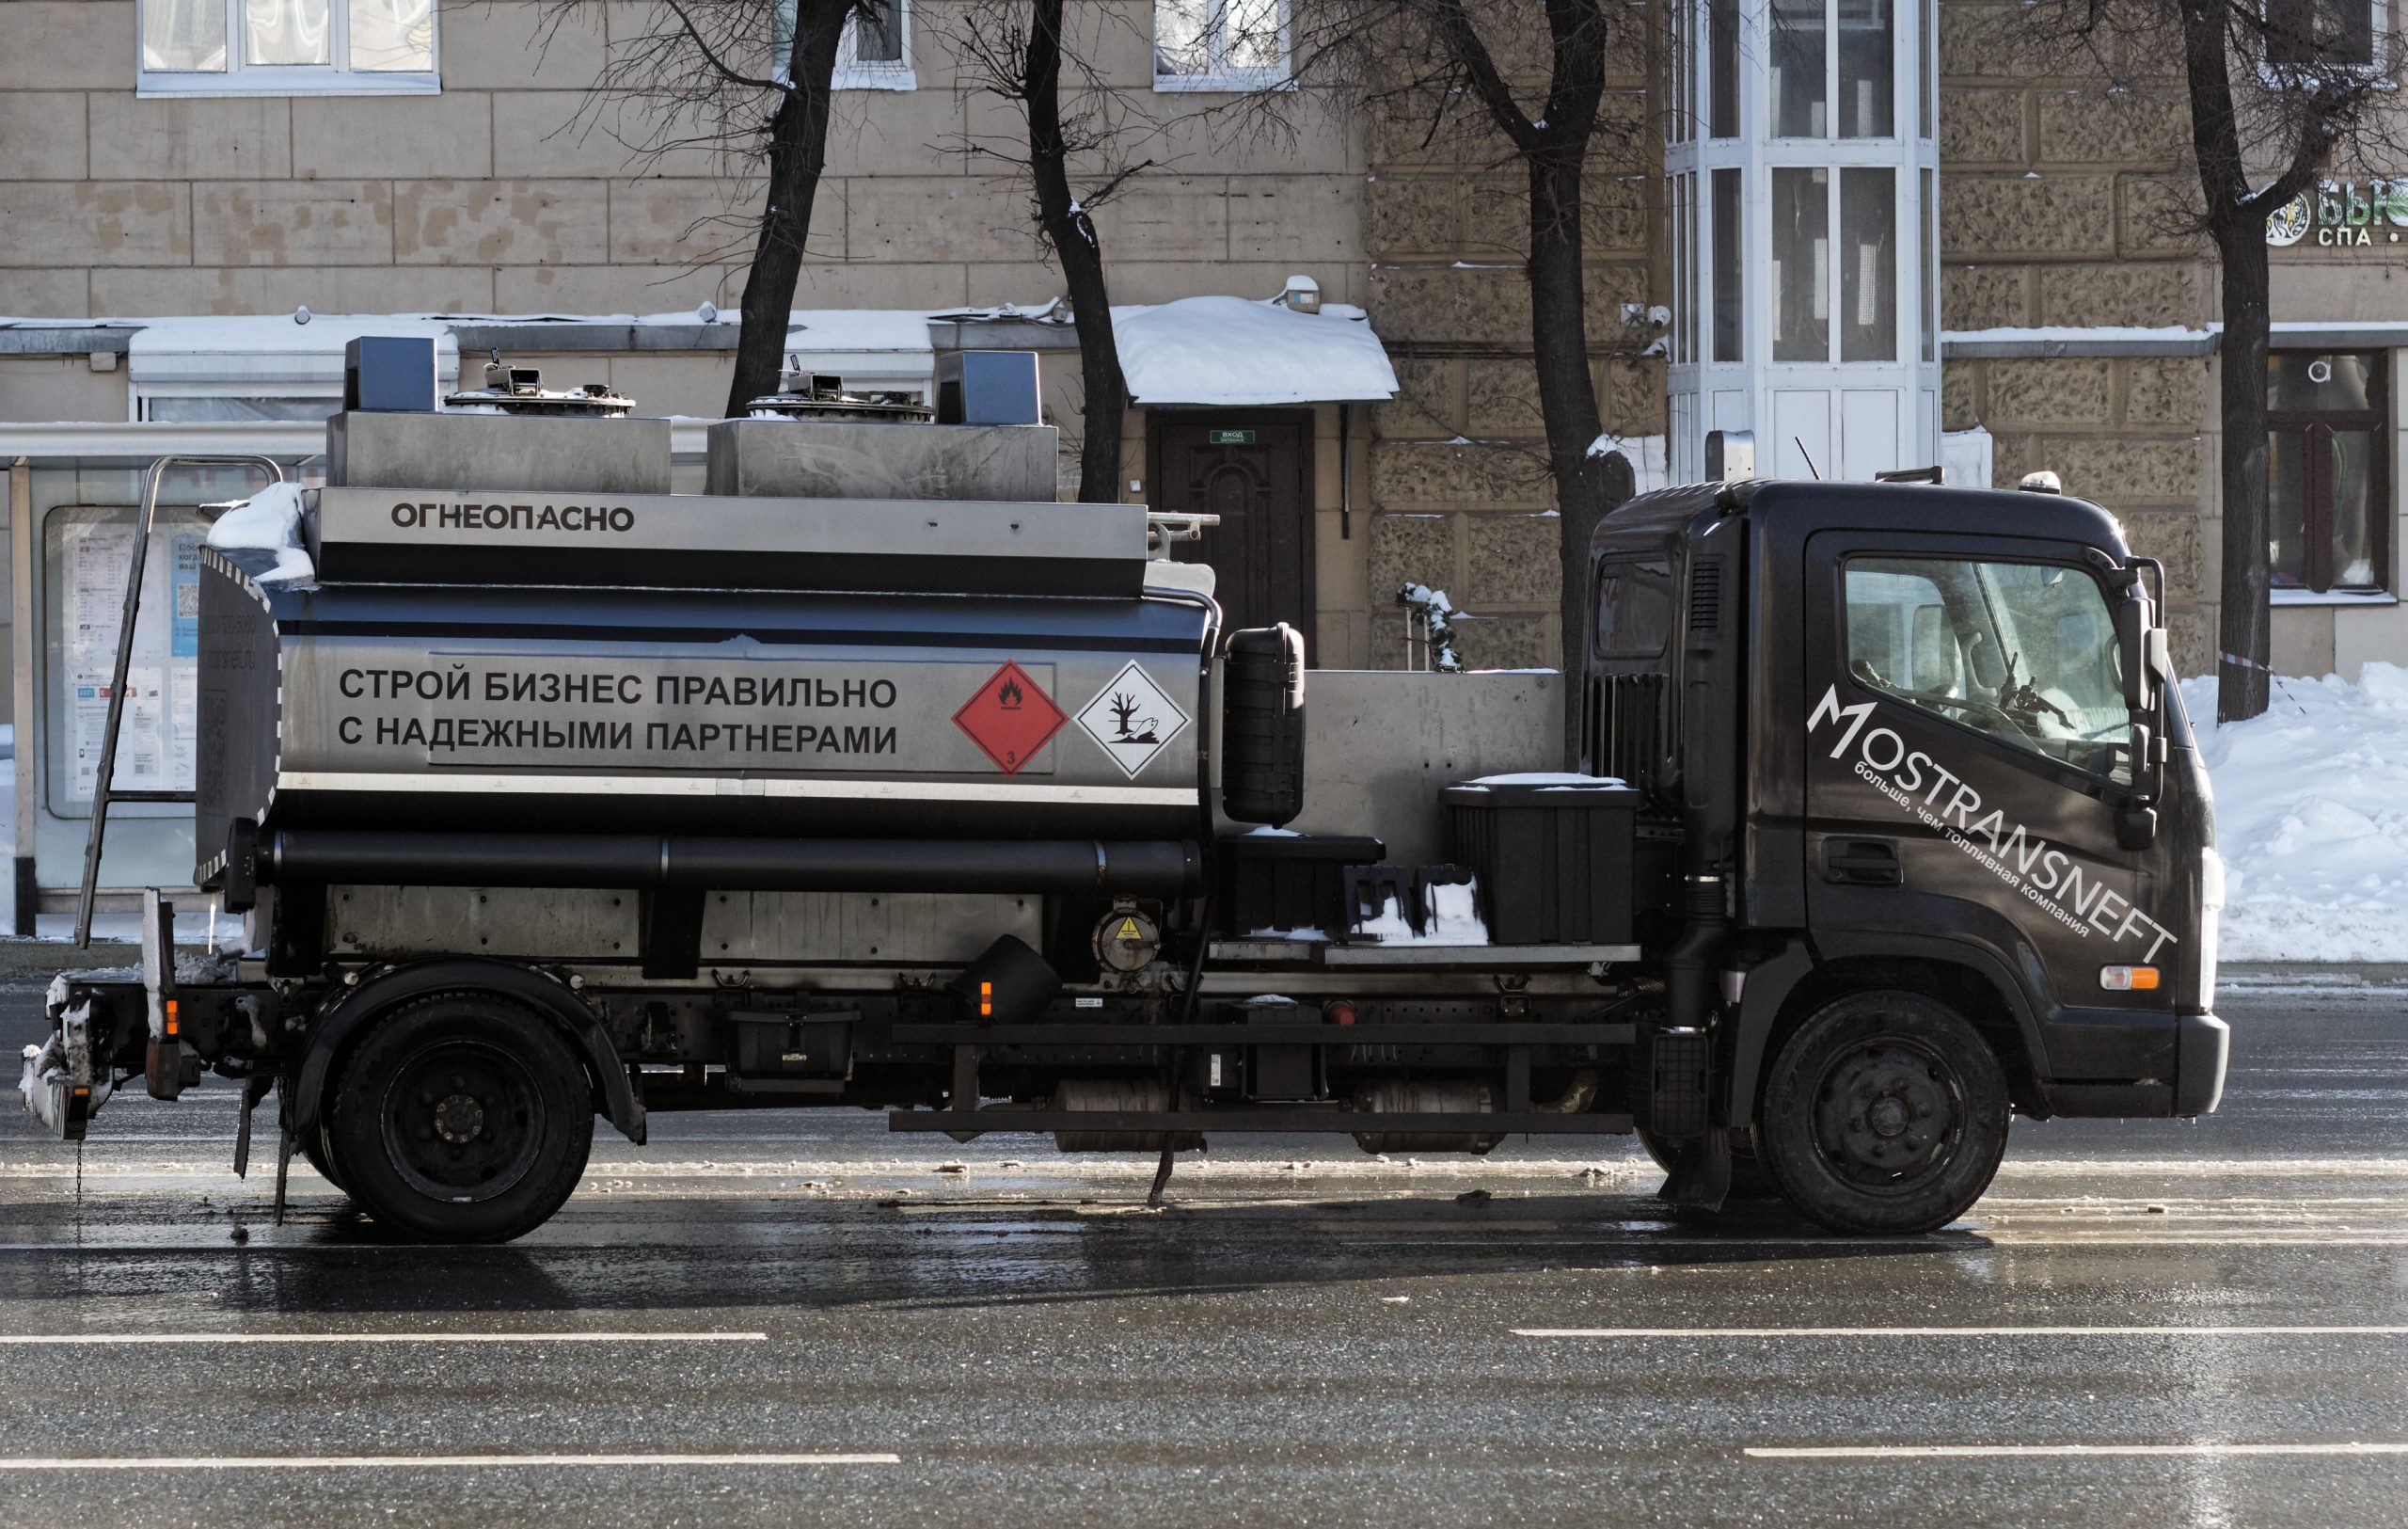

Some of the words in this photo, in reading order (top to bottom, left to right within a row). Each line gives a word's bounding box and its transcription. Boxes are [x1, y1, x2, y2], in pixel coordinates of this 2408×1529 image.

[2319, 227, 2371, 247] СПА
[391, 502, 635, 532] ОГНЕОПАСНО
[339, 664, 471, 702] СТРОЙ
[483, 672, 642, 705] БИЗНЕС
[657, 676, 897, 709] ПРАВИЛЬНО
[338, 715, 363, 745] С
[376, 717, 633, 751] НАДЕЖНЫМИ
[646, 722, 897, 755] ПАРТНЕРАМИ
[1006, 751, 1016, 764] 3
[1806, 682, 2178, 964] MOSTRANSNEFT
[1854, 760, 1911, 813] больше,
[1916, 804, 1945, 833] чем
[1943, 826, 2021, 888] топливная
[2020, 883, 2091, 939] компания
